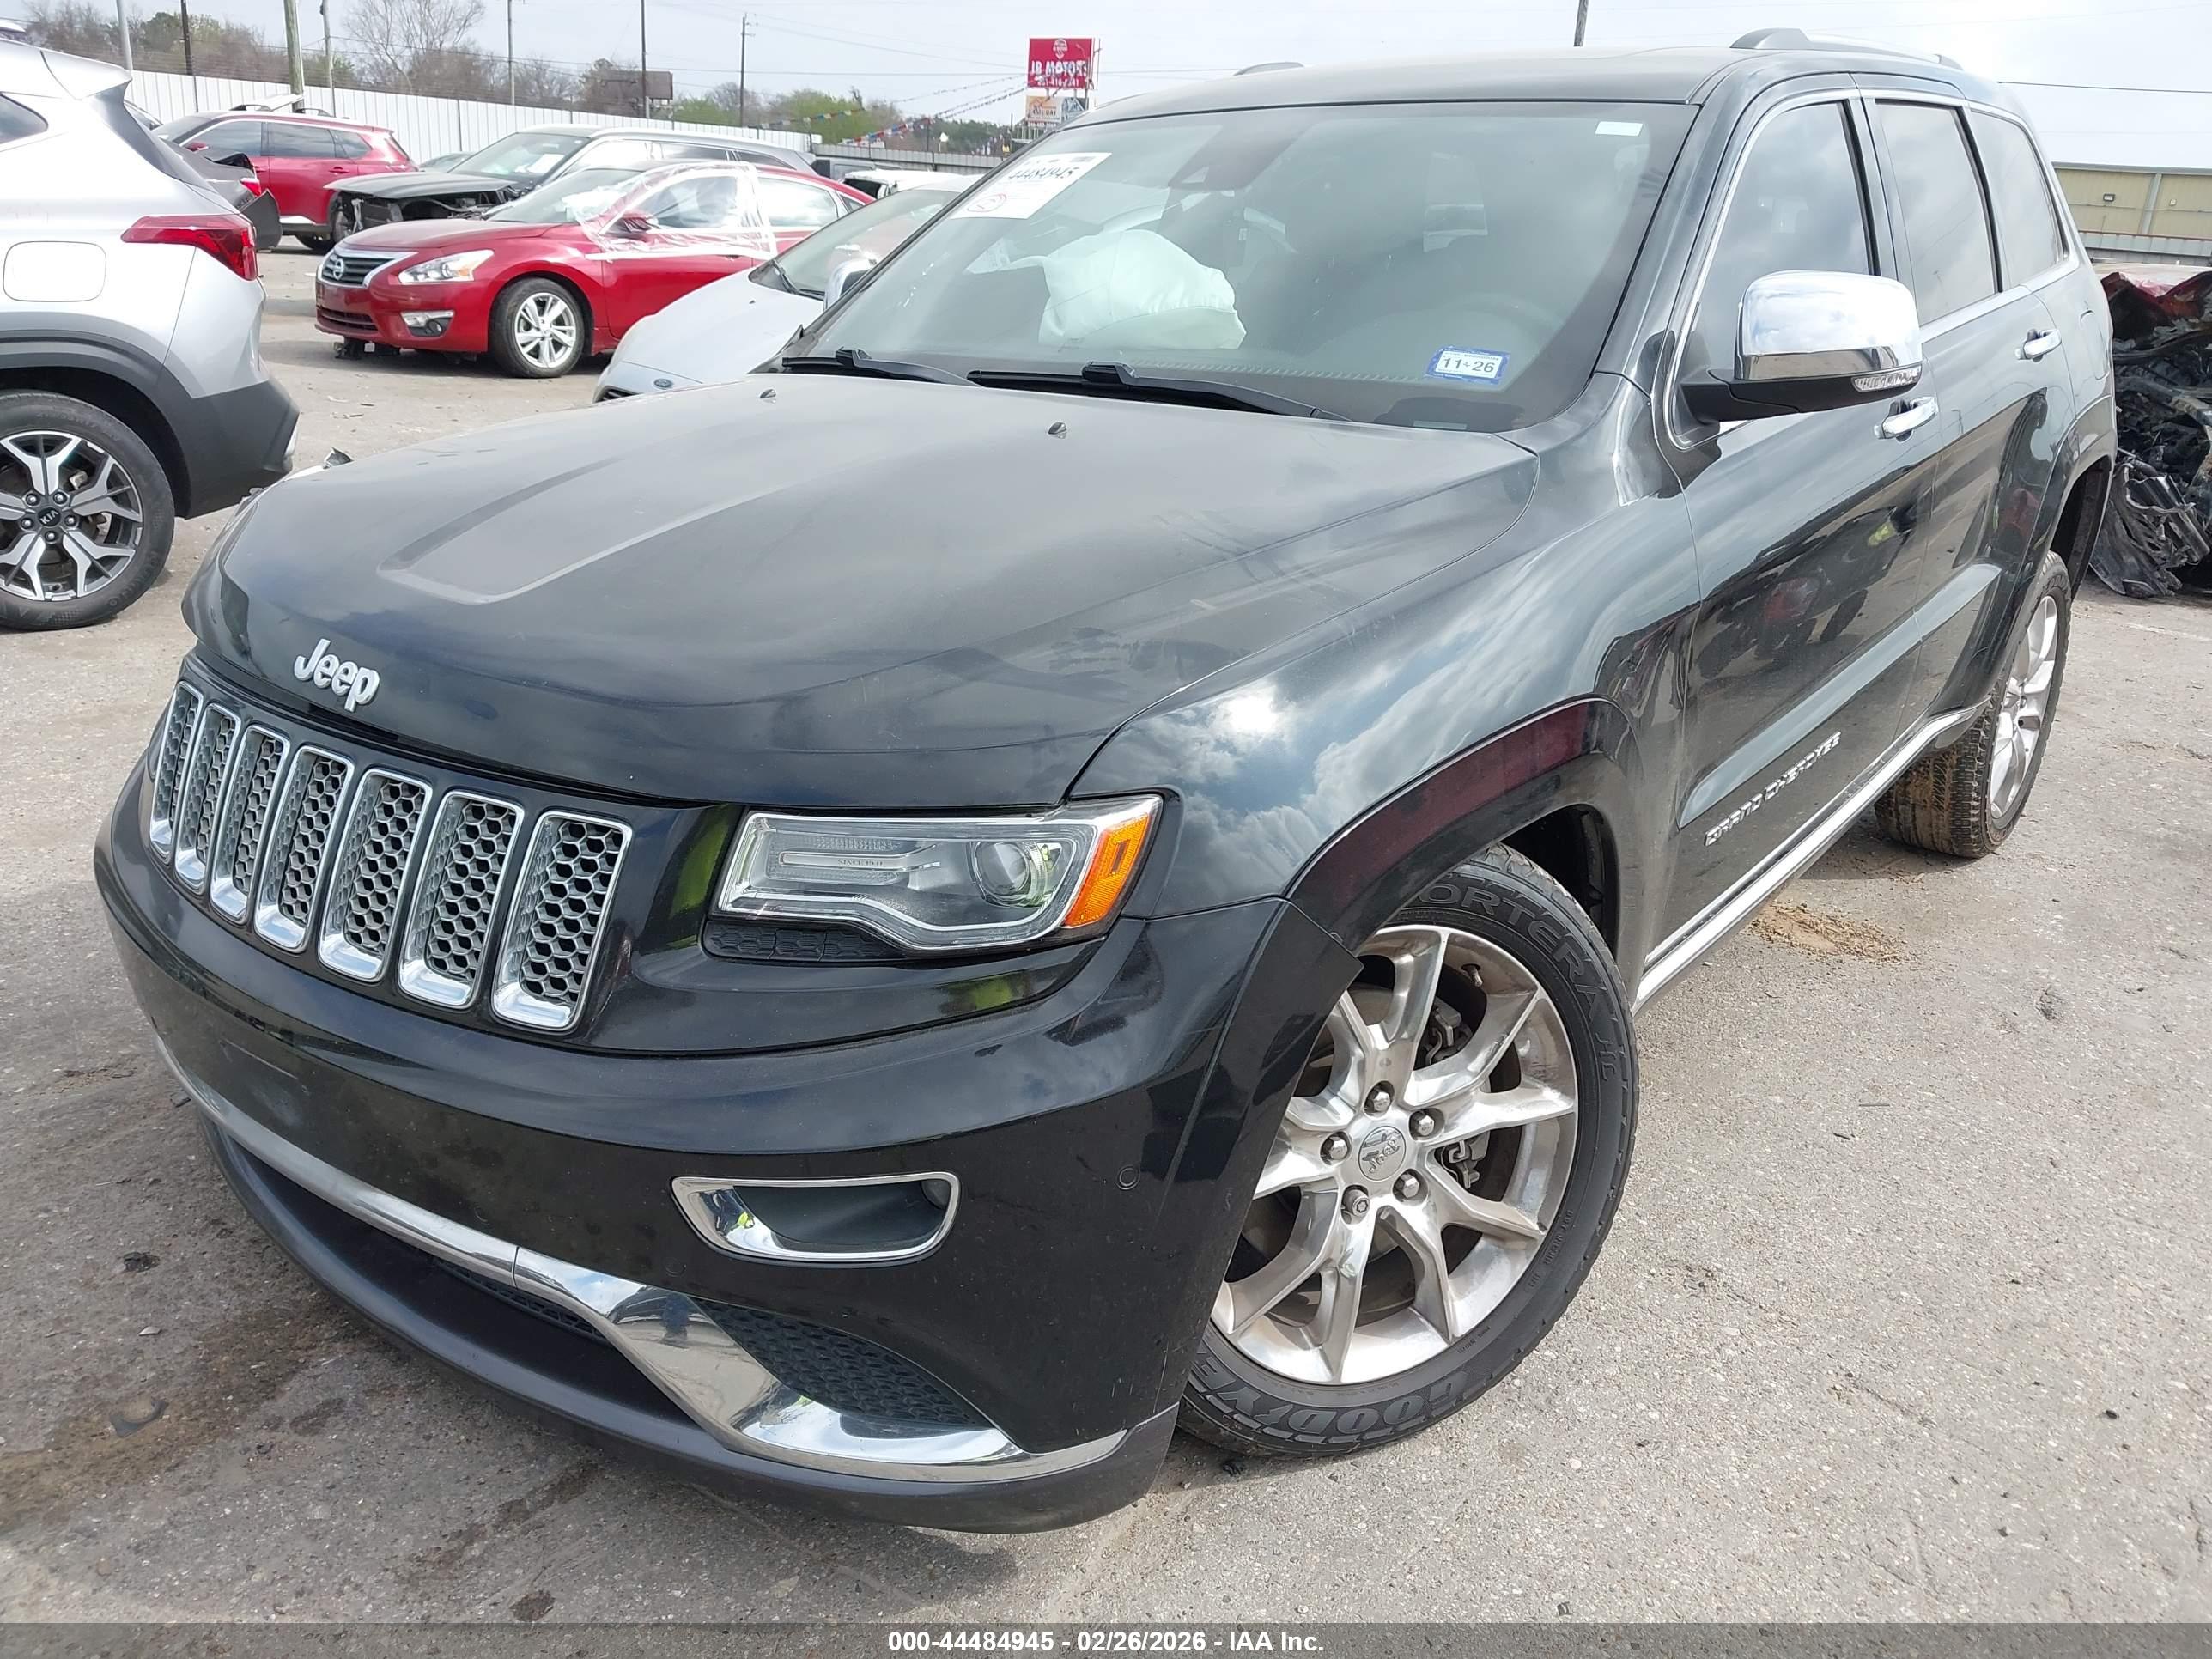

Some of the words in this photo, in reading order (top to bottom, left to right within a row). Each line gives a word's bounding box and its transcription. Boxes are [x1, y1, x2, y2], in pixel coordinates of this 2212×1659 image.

[1472, 360, 1496, 373] 26
[40, 510, 59, 525] KIA
[294, 638, 380, 713] Jeep
[1418, 882, 1611, 1022] ORTERA
[1368, 1139, 1401, 1174] Jeep
[1193, 1342, 1470, 1435] GOODYE
